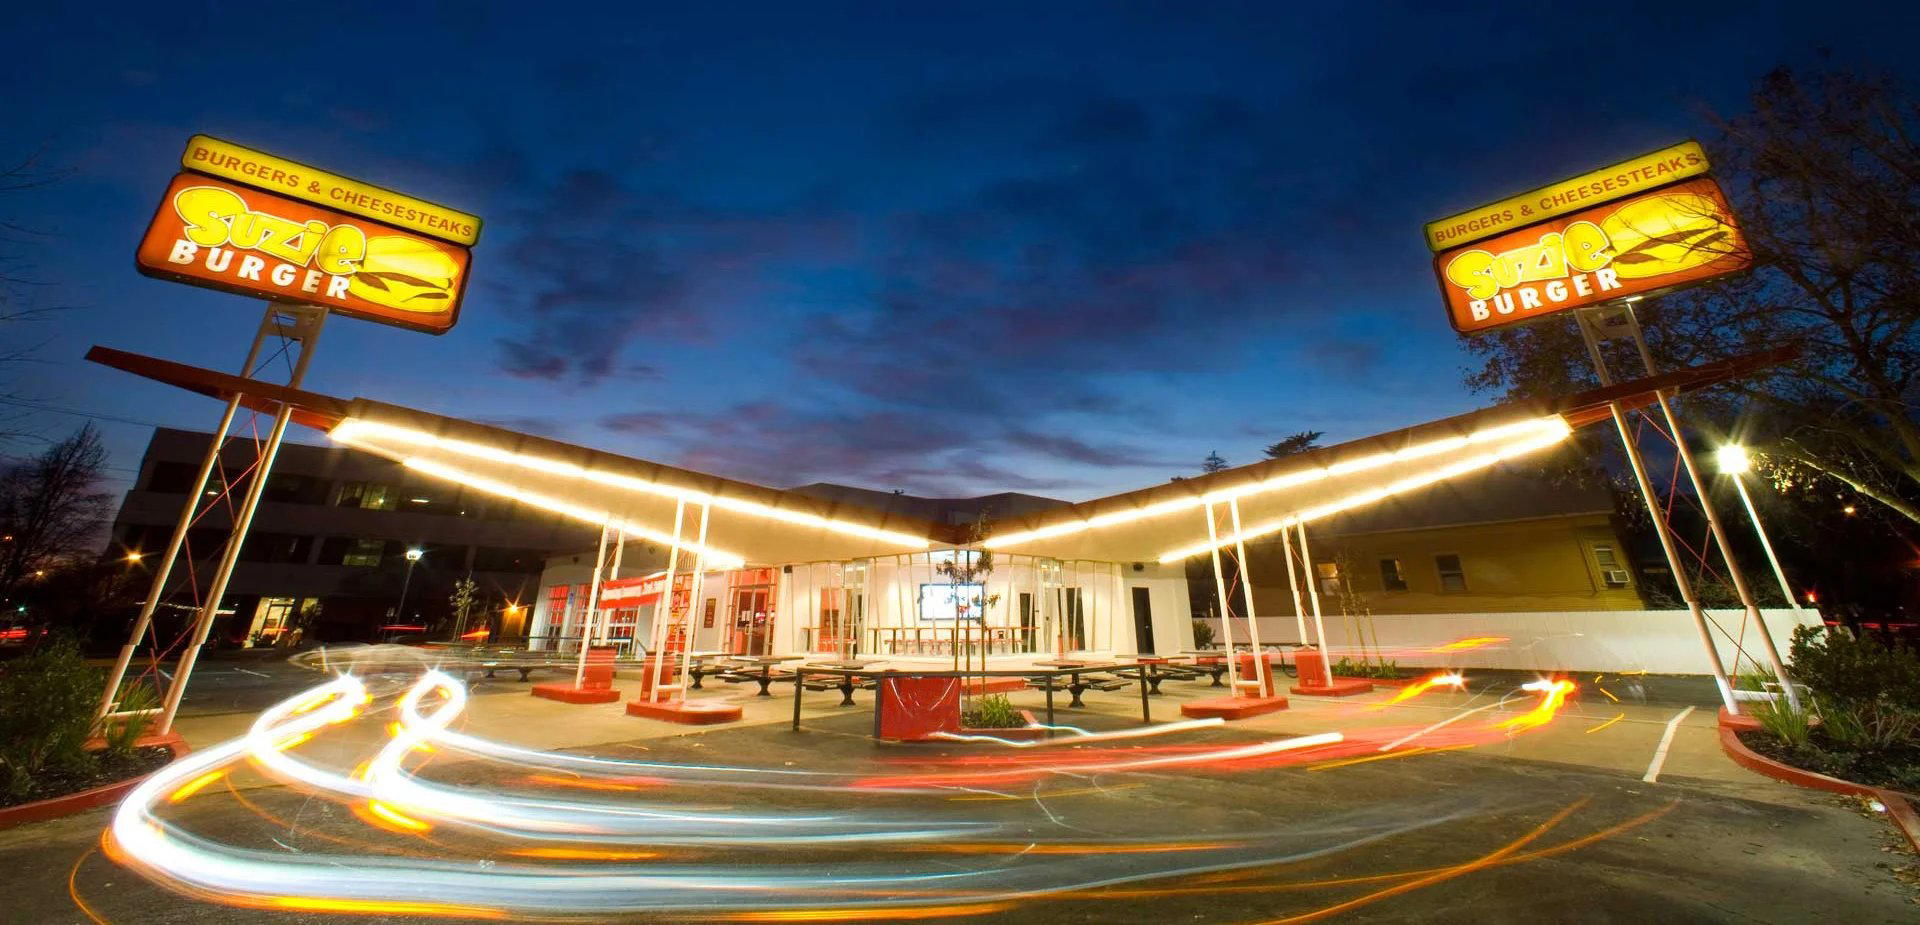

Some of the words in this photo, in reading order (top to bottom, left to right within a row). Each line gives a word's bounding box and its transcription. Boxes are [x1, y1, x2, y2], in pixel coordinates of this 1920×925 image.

[174, 186, 367, 276] Suzie
[193, 147, 300, 187] BURGERS
[308, 181, 322, 196] &
[330, 187, 472, 237] CHEESESTEAKS
[1435, 210, 1514, 243] BURGERS
[1520, 204, 1534, 217] &
[1540, 152, 1700, 212] CHEESESTEAKS
[168, 239, 351, 301] BURGER
[1447, 222, 1614, 301] Suzie
[1469, 268, 1622, 322] BURGER
